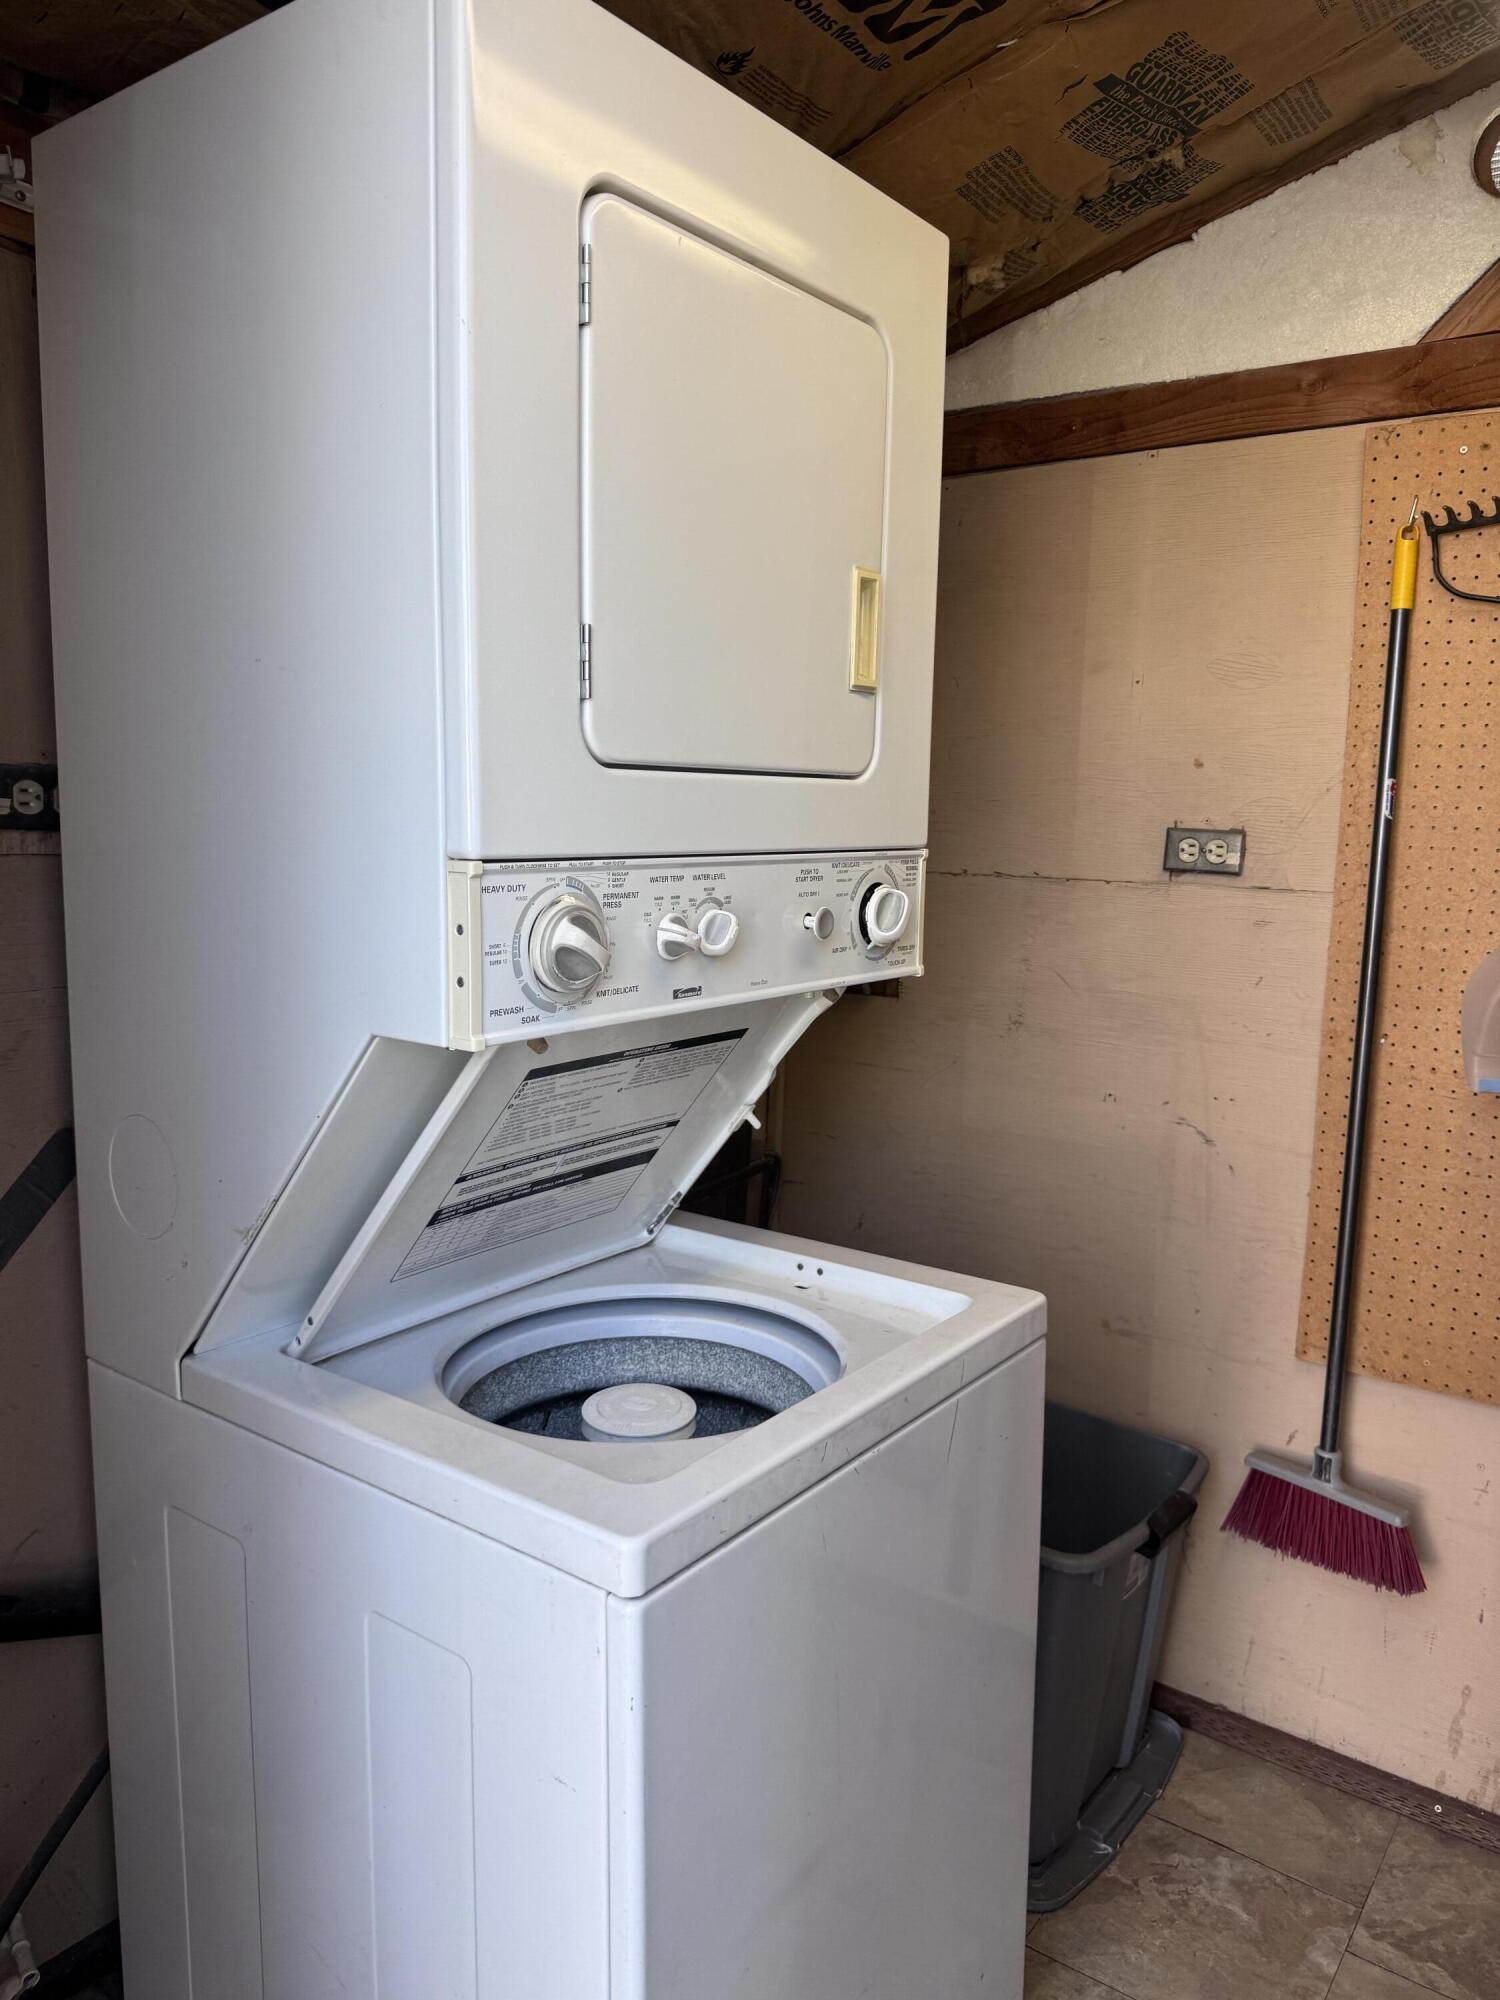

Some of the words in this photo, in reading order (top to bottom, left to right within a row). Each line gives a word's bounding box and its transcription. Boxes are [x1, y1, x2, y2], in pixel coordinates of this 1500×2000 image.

[783, 0, 839, 32] ohns
[830, 24, 893, 71] Manville
[482, 885, 506, 894] HEAVY
[507, 884, 526, 893] DUTY
[603, 892, 639, 900] PERMANENT
[603, 901, 622, 909] PRESS
[596, 985, 639, 998] KNIT/DELICATE
[490, 1006, 524, 1018] PREWASH
[521, 1015, 541, 1025] SOAK
